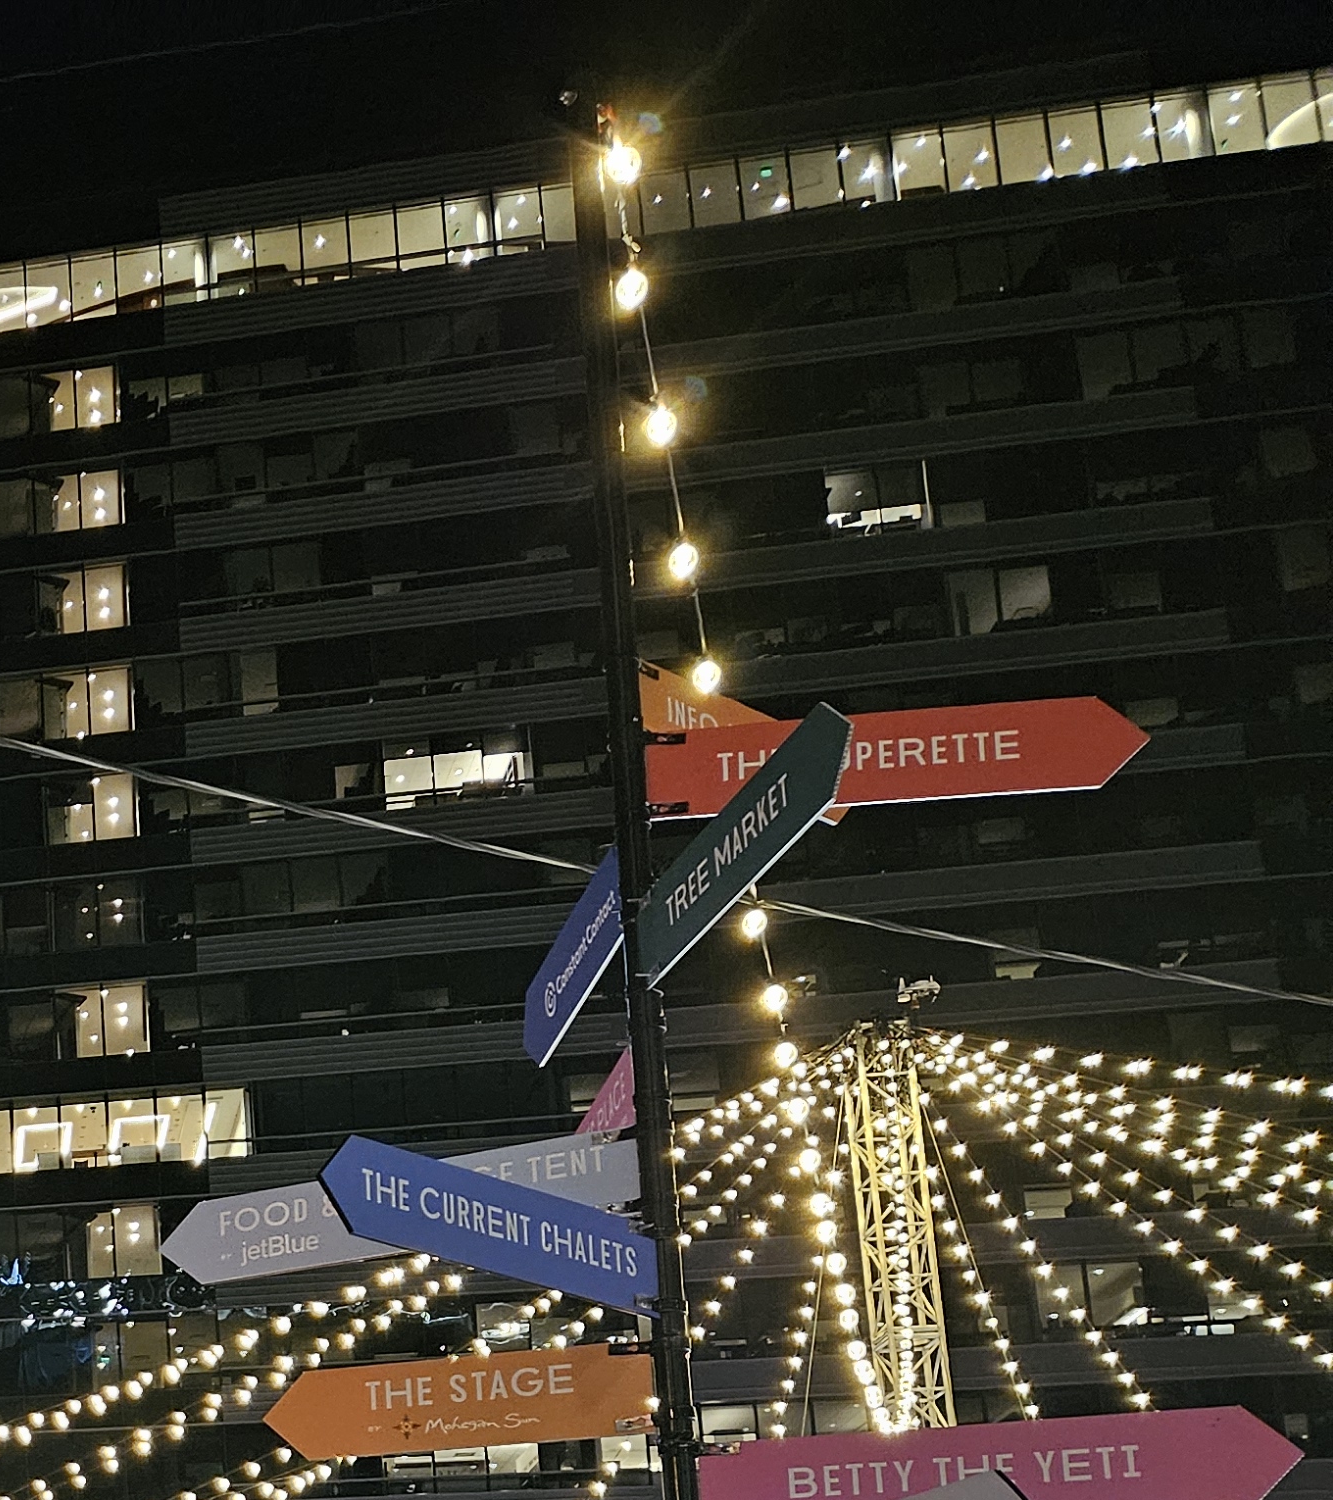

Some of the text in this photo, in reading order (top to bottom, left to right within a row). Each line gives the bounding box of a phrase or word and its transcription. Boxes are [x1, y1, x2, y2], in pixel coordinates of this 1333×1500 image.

[717, 729, 1021, 782] TH PERETTE
[665, 773, 788, 926] TREE MARKET
[556, 890, 616, 994] Constant Contact
[219, 1198, 307, 1236] FOOD
[527, 1145, 605, 1183] TENT
[362, 1168, 410, 1212] THE
[419, 1187, 530, 1246] CURRENT
[540, 1221, 637, 1277] CHALETS
[241, 1234, 319, 1267] jetBlue
[365, 1363, 575, 1411] THE STAGE
[425, 1416, 501, 1434] Mohegan
[503, 1413, 541, 1429] Sun
[788, 1460, 913, 1499] BETTY
[1034, 1445, 1142, 1483] YETI
